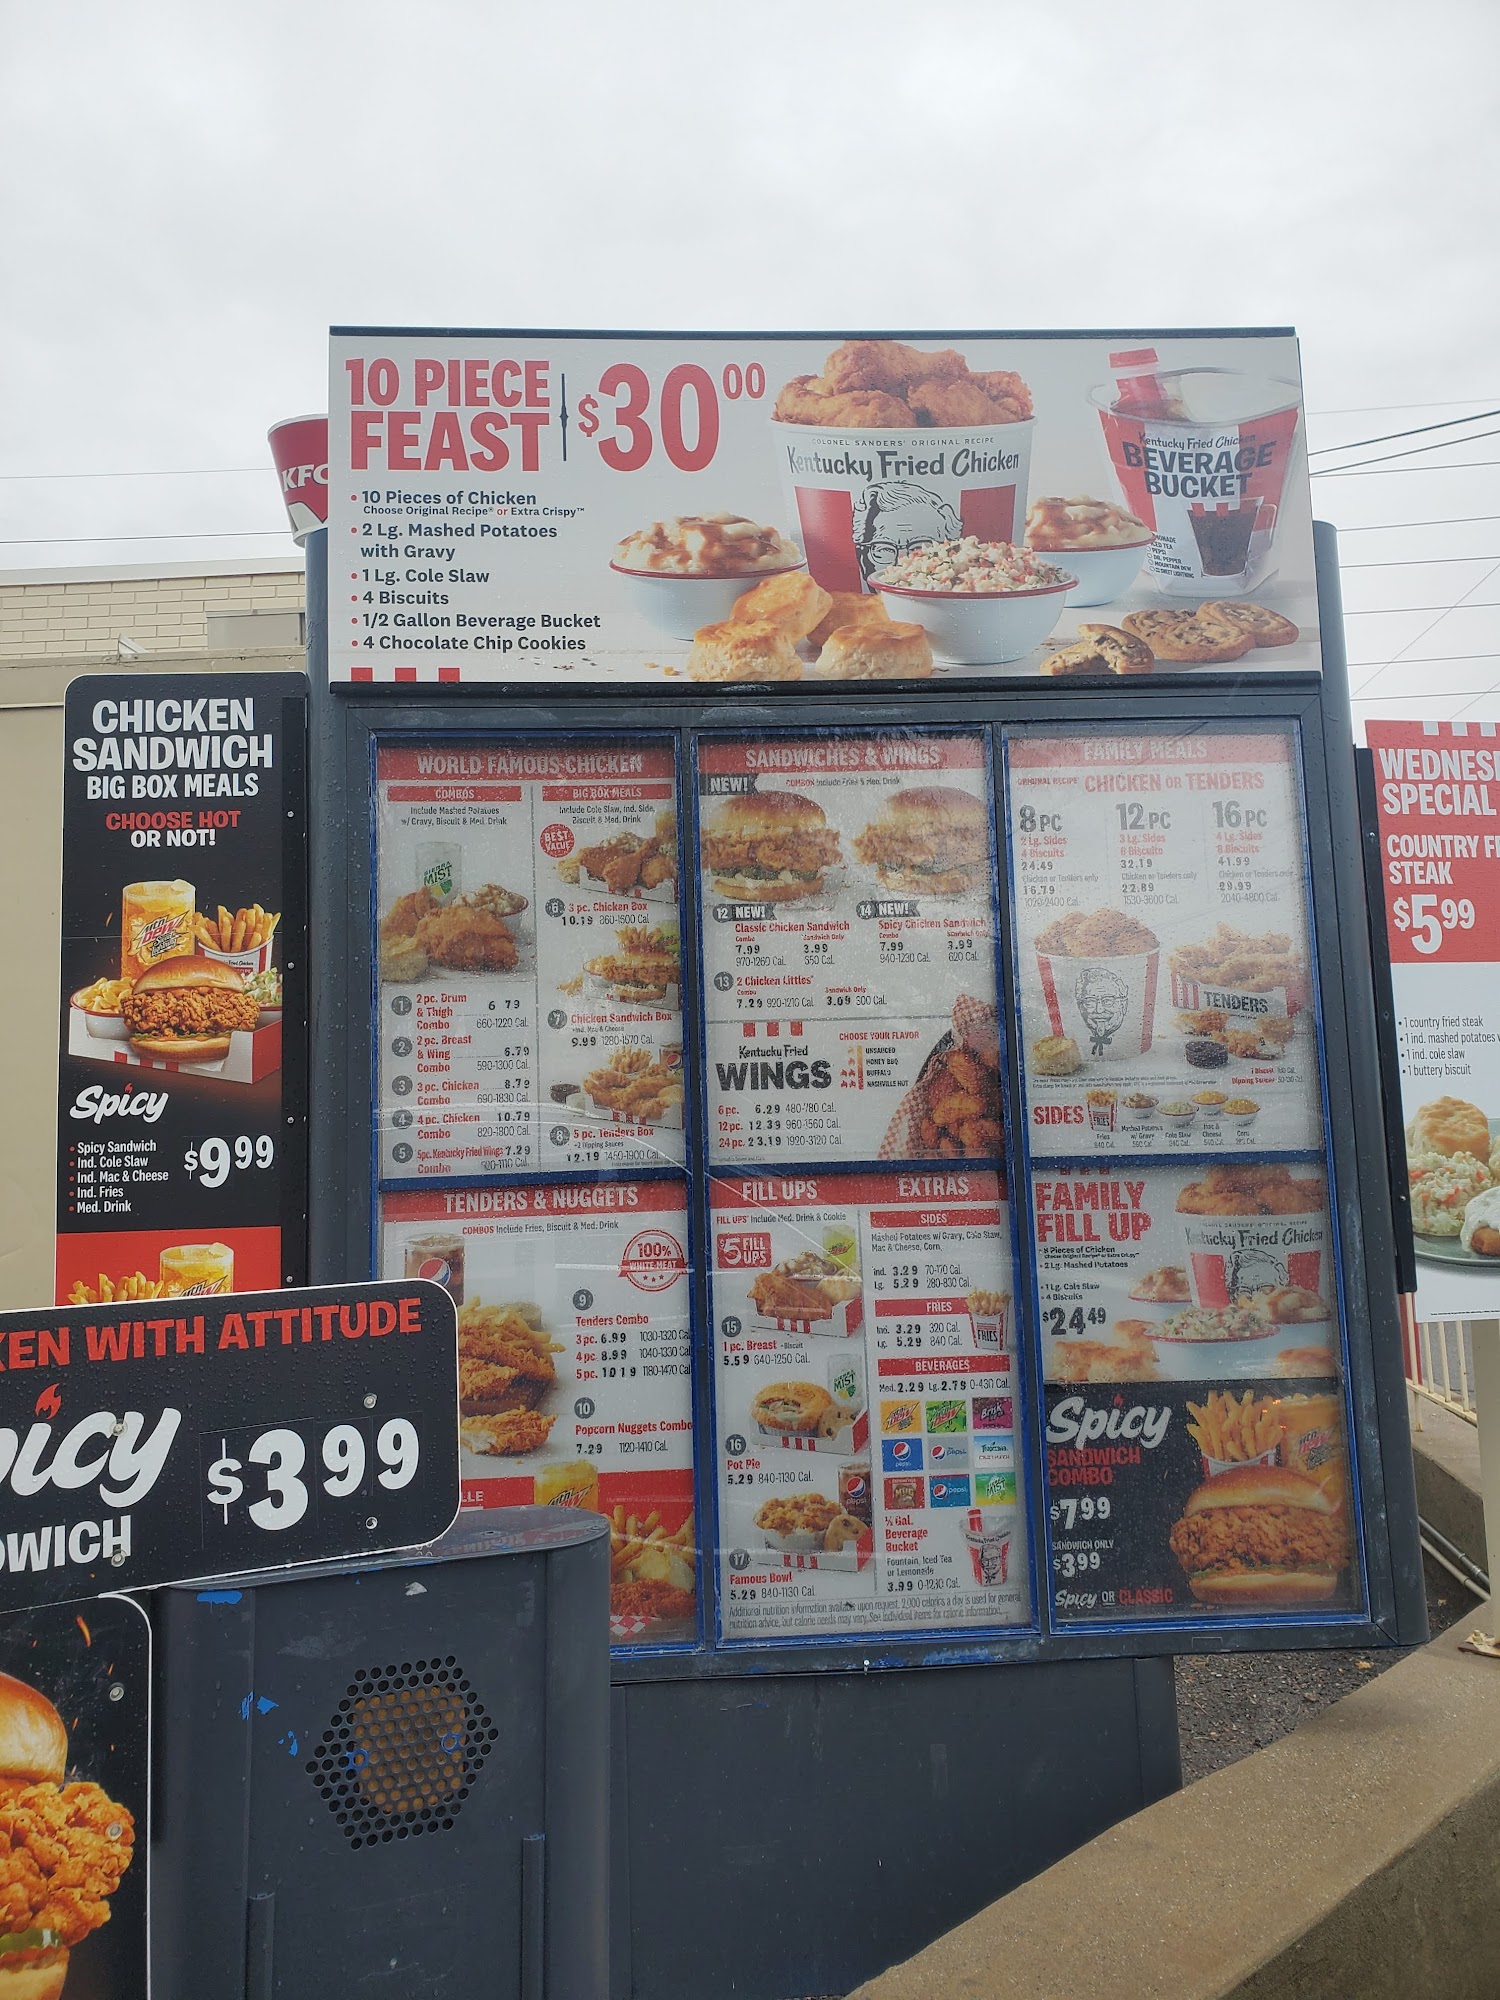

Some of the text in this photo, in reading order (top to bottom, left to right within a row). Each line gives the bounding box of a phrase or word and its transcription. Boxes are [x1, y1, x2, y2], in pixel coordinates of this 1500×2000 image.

[346, 358, 550, 407] 10 PIECE
[351, 411, 550, 472] FEAST
[812, 438, 850, 446] COLONEL
[911, 438, 960, 447] ORIGINAL
[964, 437, 995, 445] RECIPE
[1138, 432, 1256, 450] Kentucky Fried Chicken
[787, 445, 1020, 482] Kentucky Fried Chicken
[1121, 440, 1278, 475] BEVERAGE
[1143, 470, 1253, 499] BUCKET
[362, 490, 536, 505] 10 Pieces of Chicken
[363, 505, 403, 515] Choose
[406, 505, 449, 517] Original
[497, 508, 508, 516] or
[511, 507, 540, 516] Extra
[362, 523, 557, 540] 2 Lg. Mashed Potatoes
[361, 544, 455, 561] with Gravy
[362, 569, 489, 585] 1 Lg. Cole Slaw
[362, 591, 449, 605] 4 Biscuits
[362, 613, 601, 631] 1/2 Gallon Beverage Bucket
[363, 636, 586, 653] 4 Chocolate Chip Cookies
[92, 697, 254, 734] CHICKEN
[72, 733, 273, 771] SANDWICH
[746, 747, 940, 768] SANDWICHES & WINGS
[1083, 741, 1207, 761] FAMILY MEALS
[417, 754, 643, 775] WORLD FAMOUS CHICKEN
[86, 772, 259, 800] BIG BOX MEALS
[1084, 772, 1264, 793] CHICKEN OR TENDERS
[1382, 783, 1497, 816] SPECIAL
[105, 810, 241, 830] CHOOSE HOT
[1020, 805, 1062, 832] 8 PC
[1116, 803, 1171, 830] 12 PC
[1212, 801, 1268, 828] 16 PC
[130, 828, 216, 847] OR NOT!
[1387, 834, 1479, 858] COUNTRY
[1389, 861, 1453, 885] STEAK
[1204, 991, 1268, 1014] TENDERS
[1410, 1017, 1440, 1030] country
[1442, 1016, 1460, 1027] fried
[1462, 1015, 1484, 1027] steak
[1411, 1033, 1426, 1044] ind.
[1428, 1032, 1459, 1043] mashed
[1461, 1033, 1495, 1045] potatoes
[739, 1045, 808, 1060] Kentucky Fried
[1412, 1049, 1427, 1060] ind.
[1430, 1049, 1446, 1059] cole
[1447, 1048, 1465, 1059] slaw
[715, 1060, 832, 1091] WINGS
[1414, 1064, 1443, 1078] buttery
[1445, 1064, 1472, 1075] biscuit
[69, 1083, 169, 1125] Spicy
[1033, 1105, 1084, 1125] SIDES
[77, 1140, 157, 1155] Spicy Sandwich
[77, 1154, 149, 1169] Ind. Cole Slaw
[77, 1169, 169, 1184] Ind. Mac & Cheese
[77, 1185, 124, 1199] Ind. Fries
[742, 1181, 818, 1201] FILL UPS
[898, 1177, 970, 1197] EXTRAS
[1035, 1181, 1145, 1211] FAMILY
[77, 1200, 132, 1214] Med. Drink
[444, 1186, 639, 1213] TENDERS & NUGGETS
[1037, 1213, 1152, 1242] FILL UP
[638, 1243, 672, 1258] 100%
[629, 1261, 677, 1270] WHITE MEAT
[926, 1302, 952, 1313] FRIES
[85, 1315, 205, 1362] WITH
[218, 1297, 422, 1350] ATTITUDE
[576, 1314, 648, 1327] Tenders Combo
[915, 1360, 970, 1372] BEVERAGES
[575, 1421, 657, 1436] Popcorn Nuggets
[1046, 1394, 1172, 1450] Spicy
[1047, 1447, 1141, 1468] SANDWICH
[1048, 1467, 1113, 1486] COMBO
[1051, 1539, 1114, 1551] SANDWICH ONLY
[730, 1573, 793, 1584] Famous Bowl
[1055, 1588, 1173, 1609] Spicy OR CLASSIC
